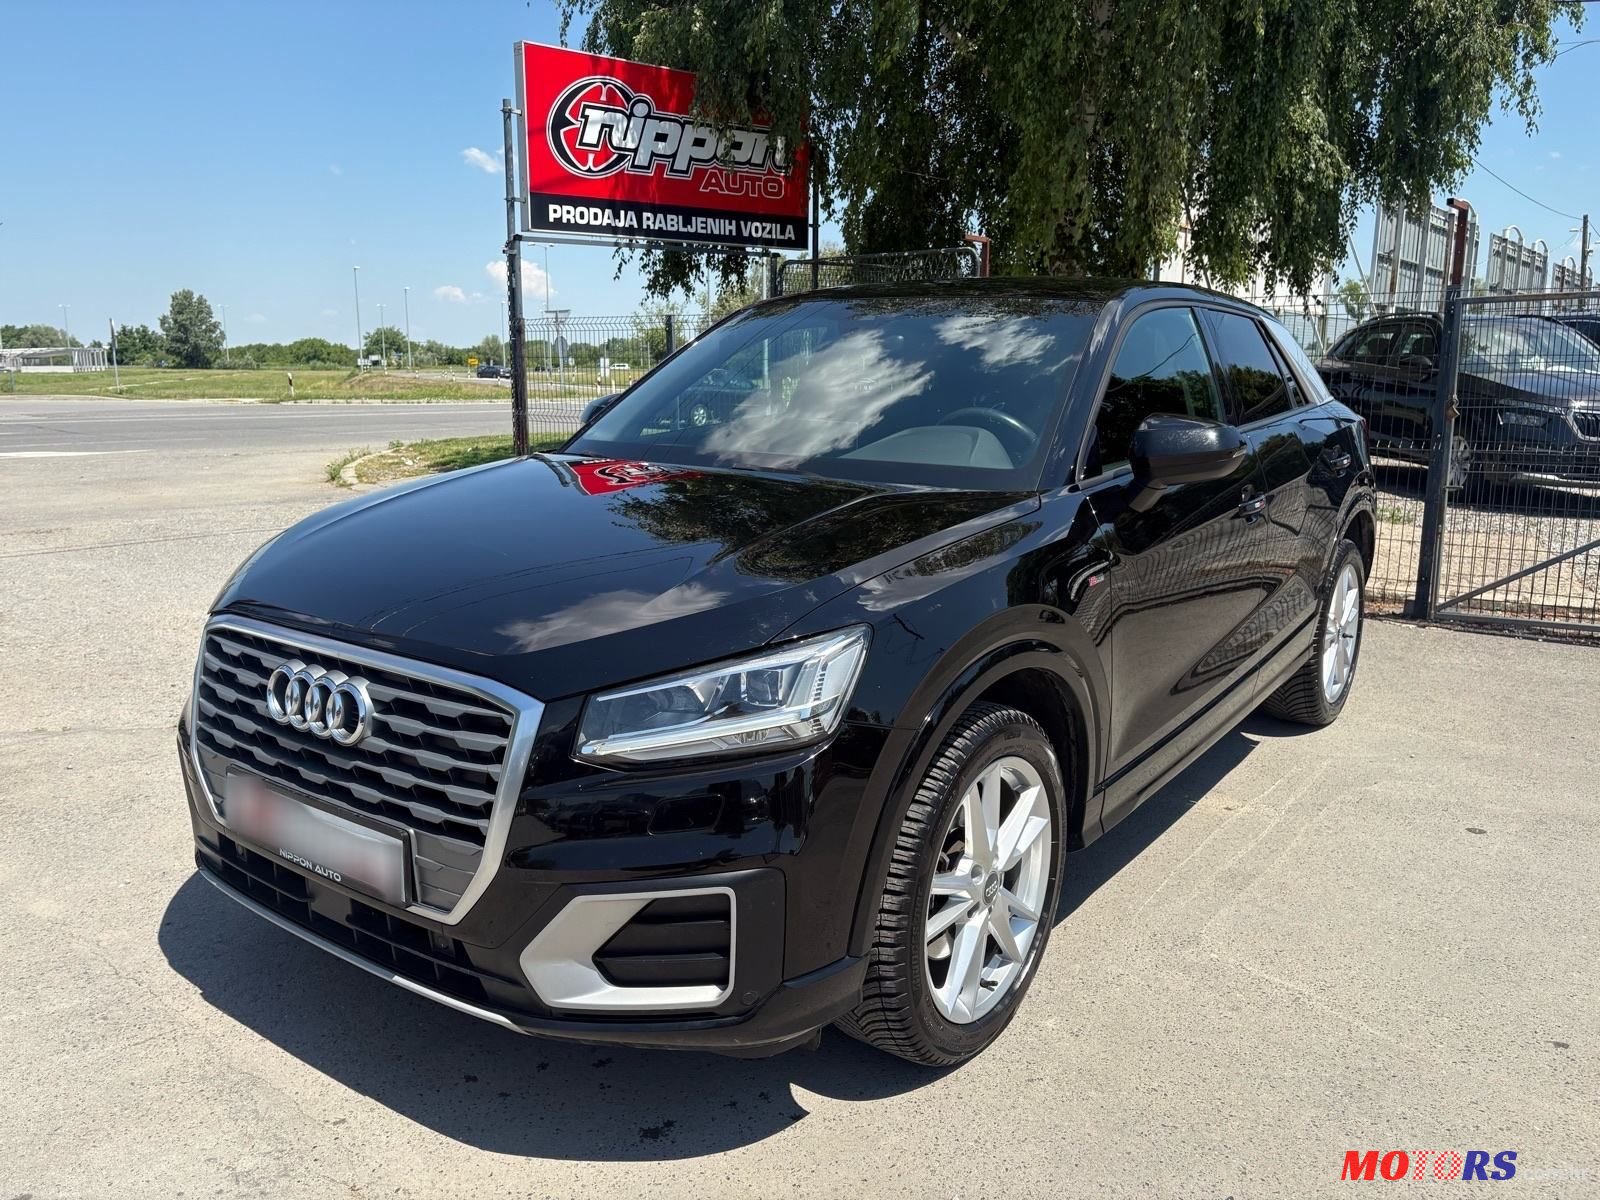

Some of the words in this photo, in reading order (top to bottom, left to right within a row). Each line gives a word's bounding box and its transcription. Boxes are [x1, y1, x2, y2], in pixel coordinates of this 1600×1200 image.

[699, 169, 784, 199] AUTO
[548, 204, 638, 229] PRODAJA
[642, 212, 737, 237] RABLJENIH
[742, 222, 796, 241] VOZILA
[280, 849, 312, 870] NIPPON
[315, 864, 341, 882] AUTO
